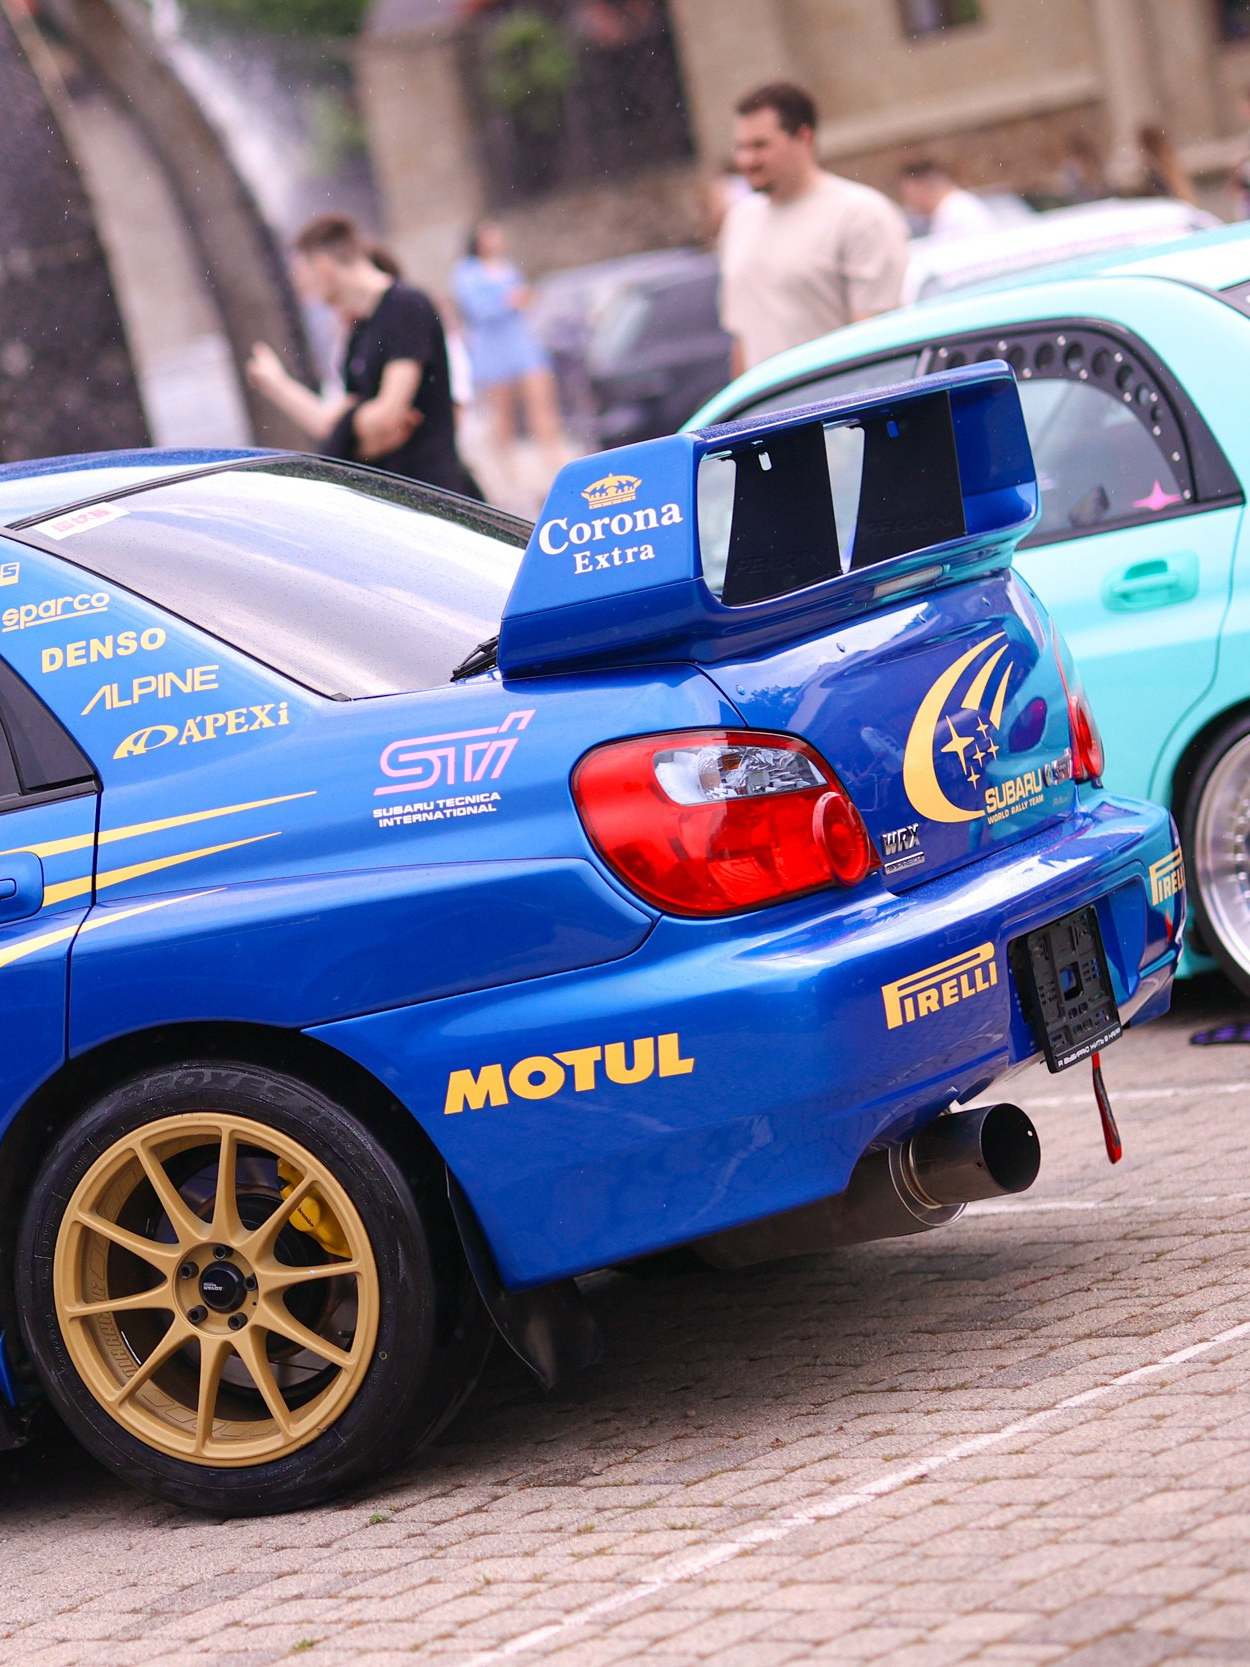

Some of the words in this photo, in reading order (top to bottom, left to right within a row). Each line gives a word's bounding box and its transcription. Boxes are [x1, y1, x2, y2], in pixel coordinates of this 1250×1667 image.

[538, 502, 684, 555] Corona
[573, 543, 655, 574] Extra
[2, 592, 111, 632] sparco
[41, 627, 166, 673] DENSO
[80, 664, 219, 716] ALPINE
[372, 801, 435, 818] SUBARU
[436, 791, 501, 808] TECNICA
[985, 768, 1043, 813] SUBARU
[987, 809, 1010, 825] WORLD
[1011, 801, 1029, 814] RALLY
[1029, 794, 1044, 807] TEAM
[378, 803, 497, 828] INTERNATIONAL
[881, 823, 920, 856] WRX
[881, 941, 998, 1030] PIRELLI
[443, 1032, 695, 1115] MOTUL
